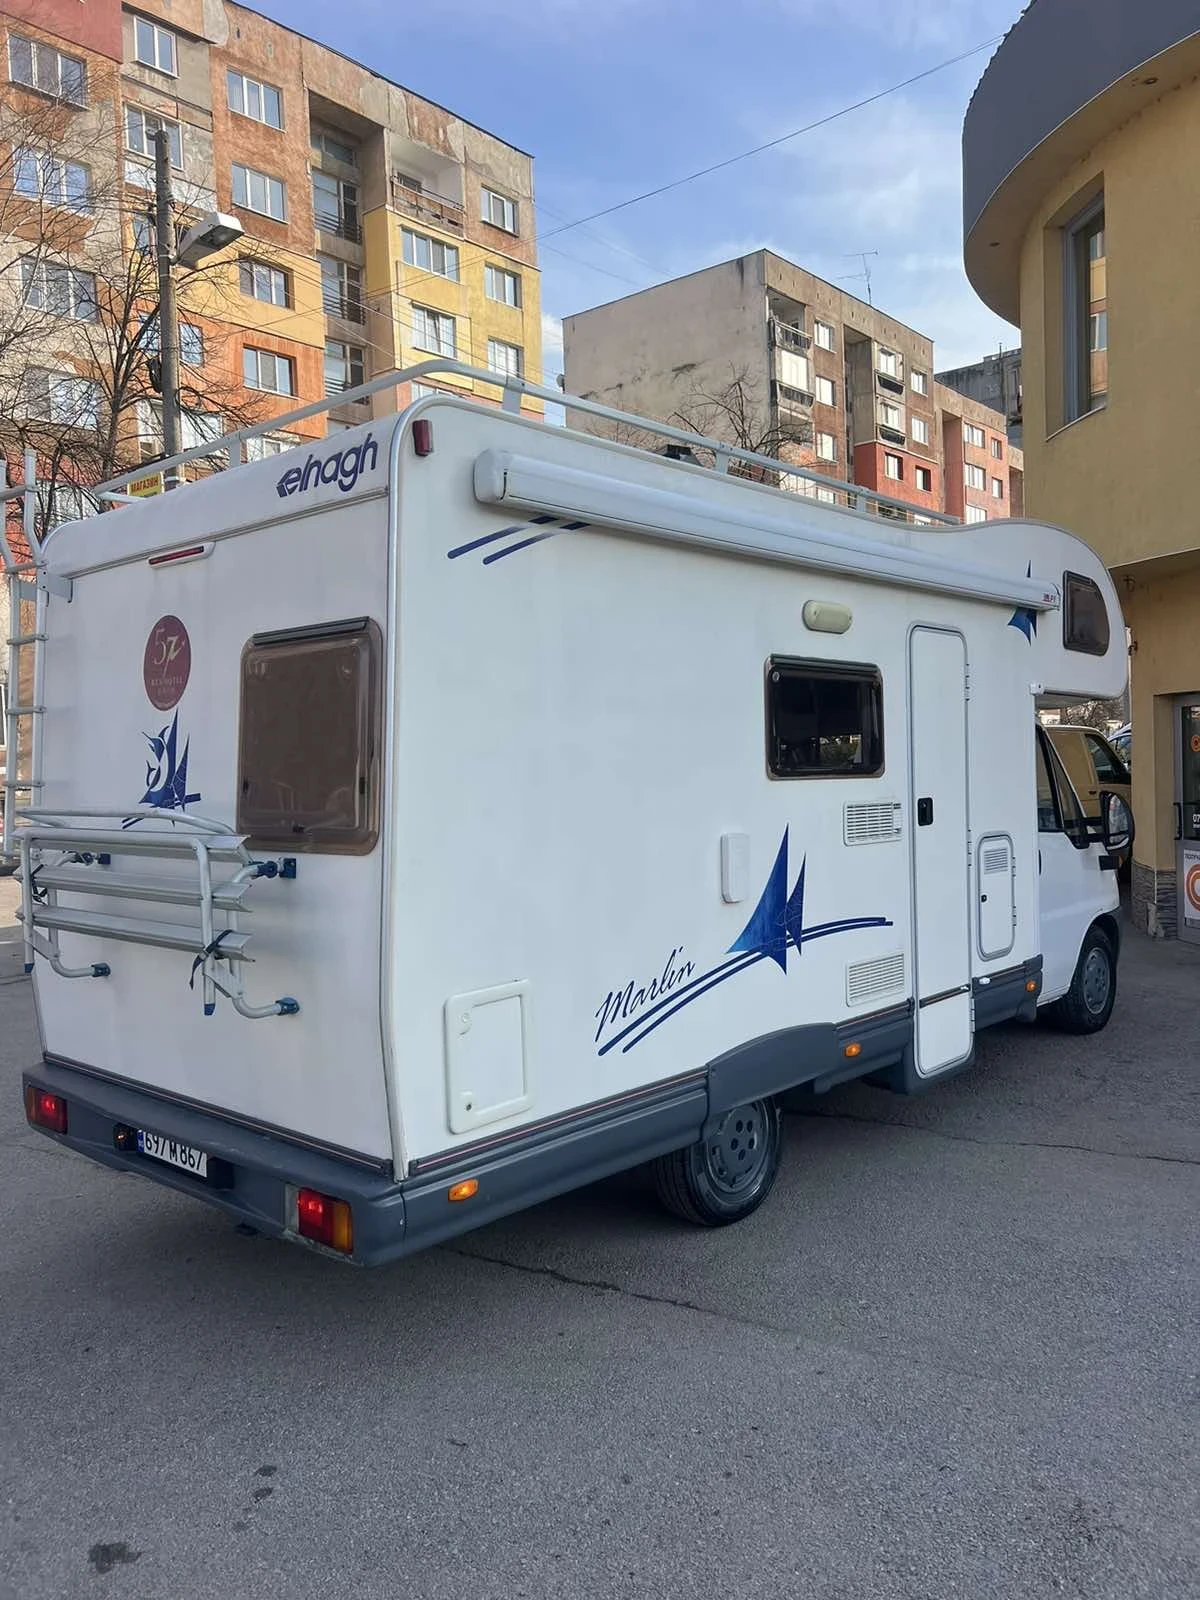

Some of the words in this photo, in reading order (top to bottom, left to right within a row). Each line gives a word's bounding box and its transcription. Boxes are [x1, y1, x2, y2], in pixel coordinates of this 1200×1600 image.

[130, 475, 159, 493] МАГАЗИН
[276, 432, 378, 498] elnagh
[595, 946, 695, 1042] Marlin
